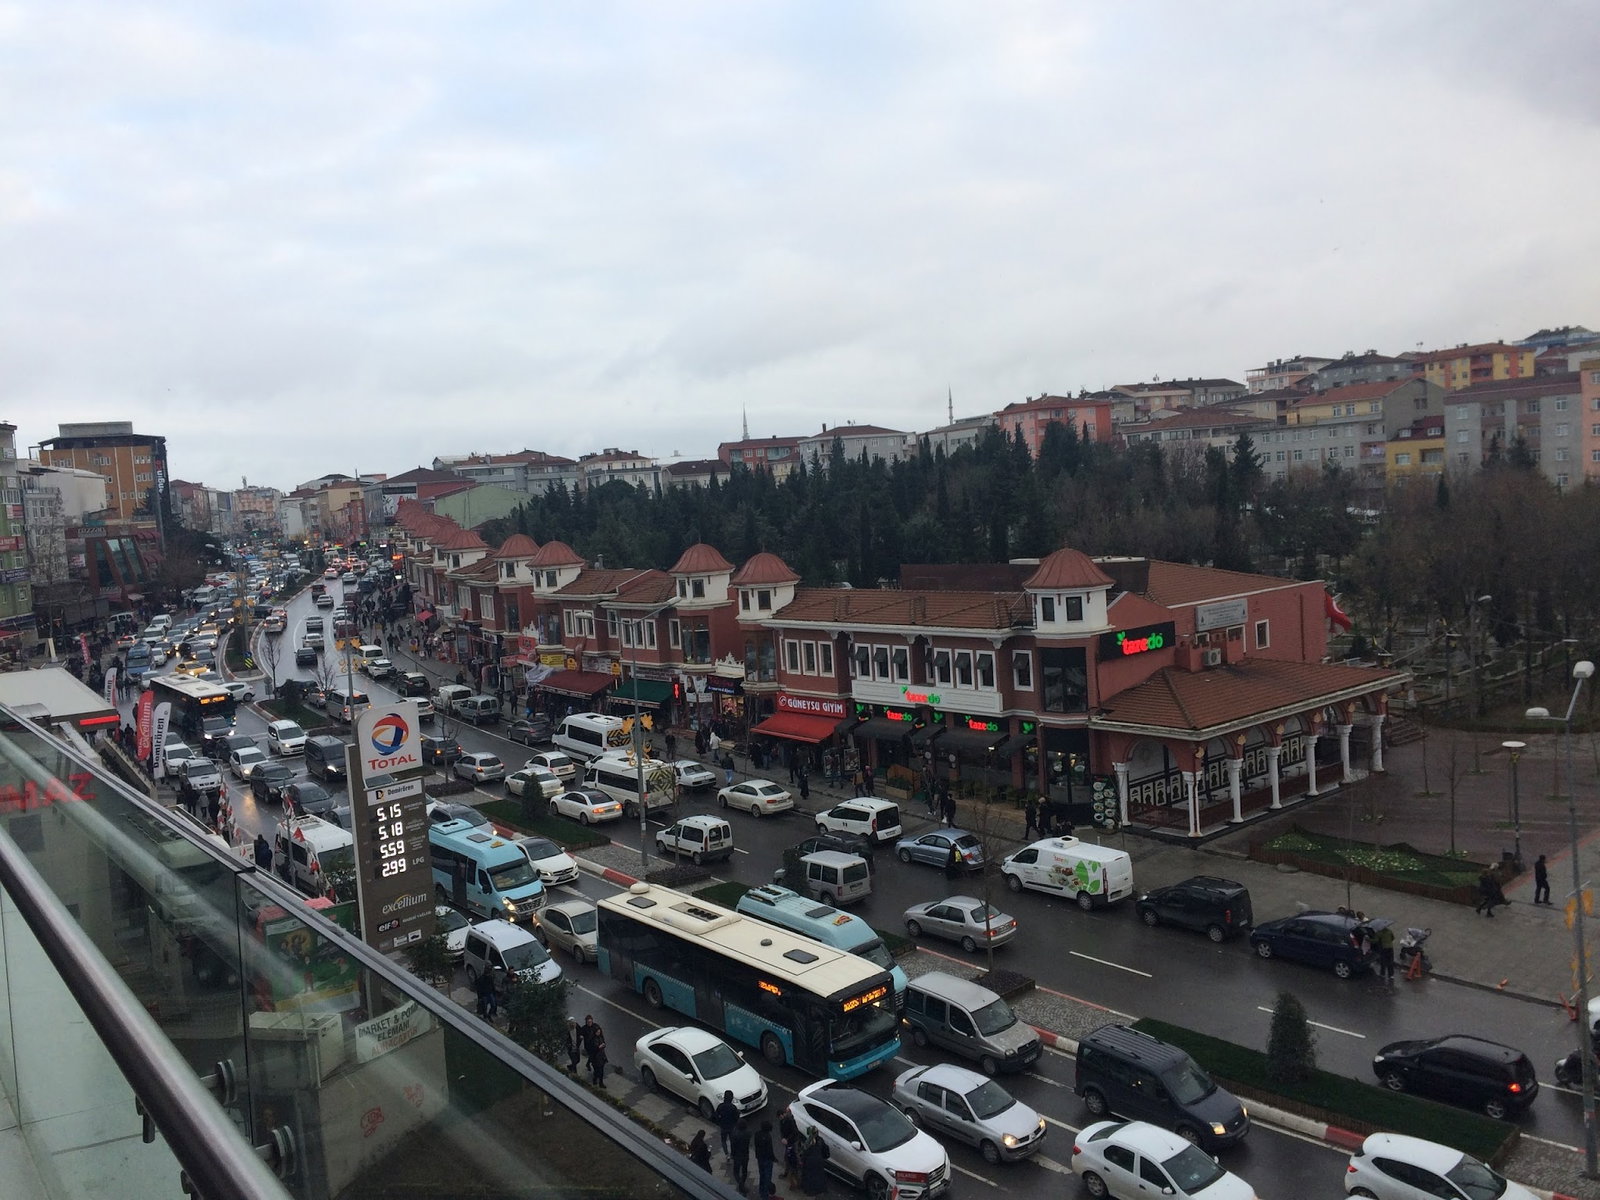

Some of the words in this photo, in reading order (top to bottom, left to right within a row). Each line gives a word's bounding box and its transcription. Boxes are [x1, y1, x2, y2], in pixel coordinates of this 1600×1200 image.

[822, 701, 843, 714] GİYİM
[968, 719, 998, 732] tazedo
[367, 753, 417, 771] TOTAL
[412, 856, 425, 865] LPG
[382, 893, 427, 915] excellium
[358, 1017, 391, 1038] MARKET
[393, 1014, 400, 1024] &
